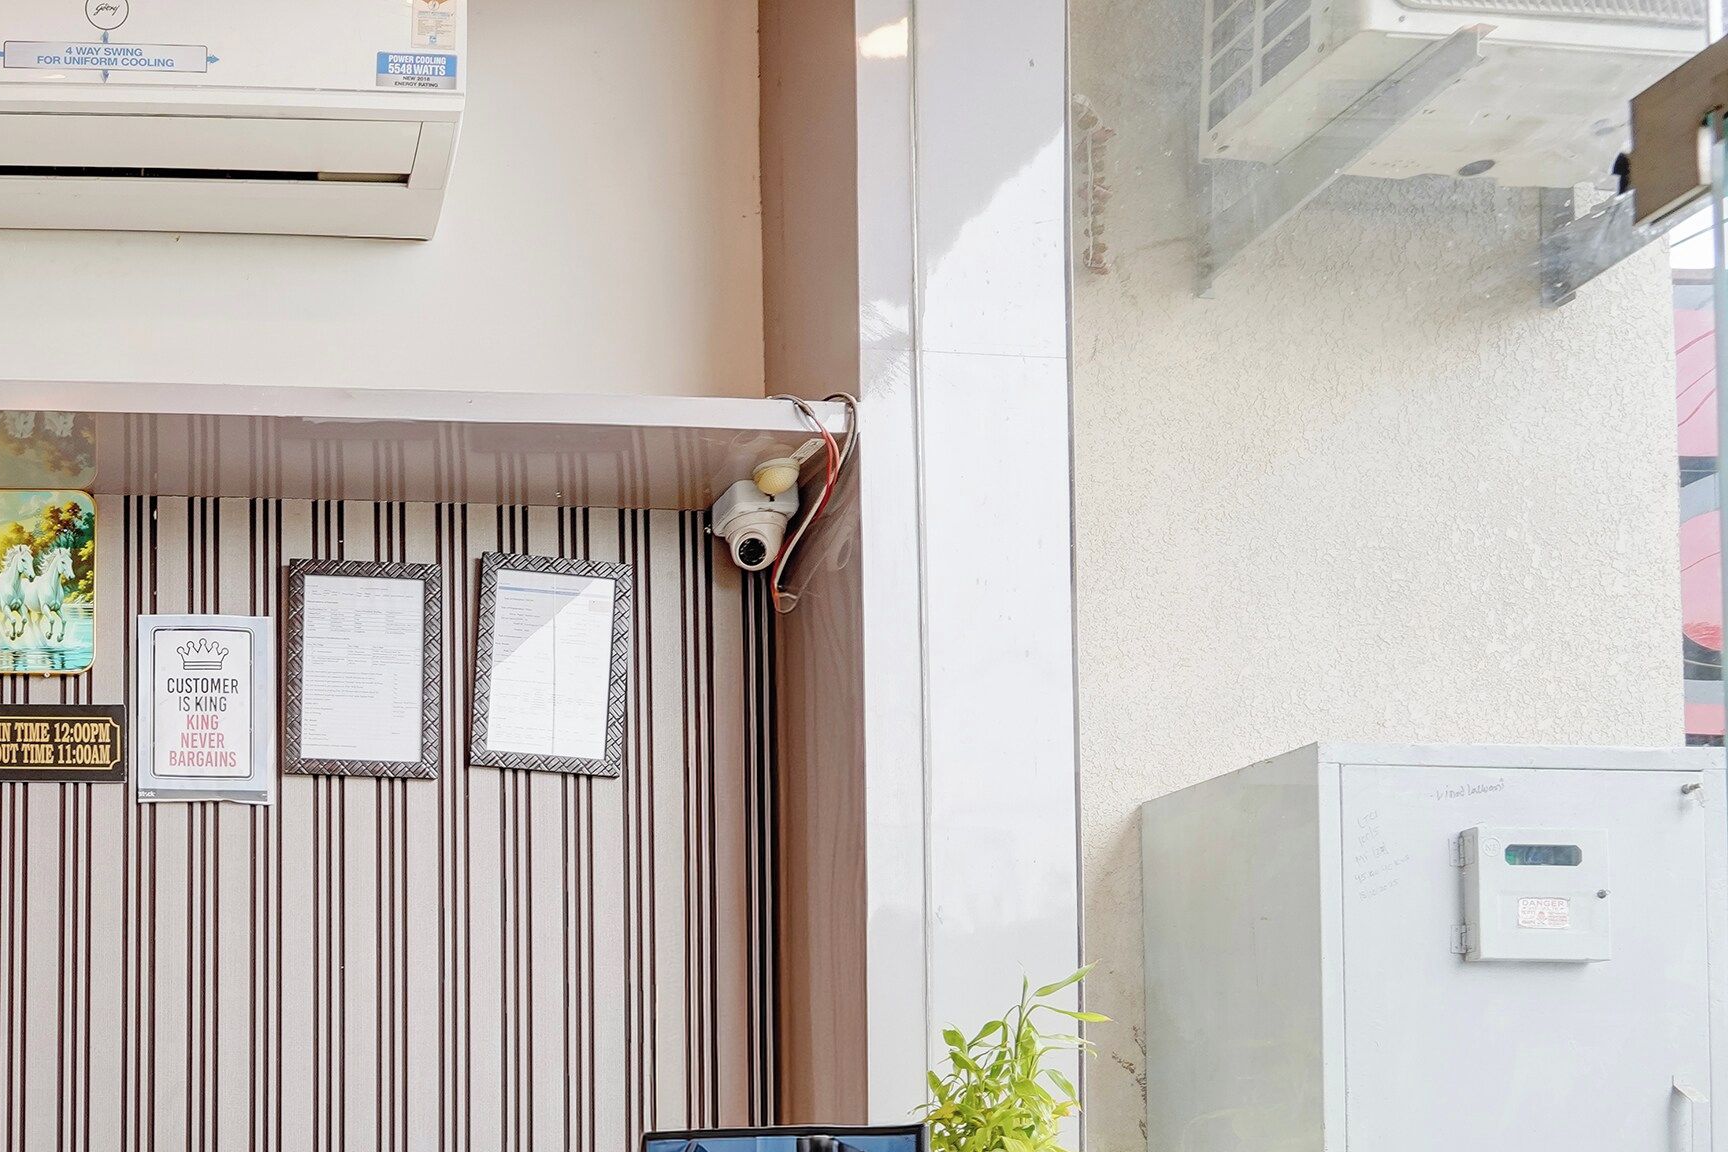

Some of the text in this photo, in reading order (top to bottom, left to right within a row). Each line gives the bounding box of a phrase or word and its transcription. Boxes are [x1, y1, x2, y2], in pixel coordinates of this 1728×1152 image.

[65, 47, 143, 57] 4 WAY SWING
[388, 55, 447, 65] POWER COOLING
[37, 56, 175, 67] FOR UNIFORM COOLING
[388, 63, 446, 76] 5548 WATTS
[167, 677, 239, 694] CUSTOMER
[179, 696, 227, 712] IS KING
[186, 714, 219, 730] KING
[14, 722, 51, 743] TIME
[54, 722, 111, 743] 12:00PM
[180, 732, 225, 749] NEVER
[21, 744, 55, 764] TIME
[57, 744, 111, 765] 11:00AM
[169, 750, 237, 767] BARGAINS
